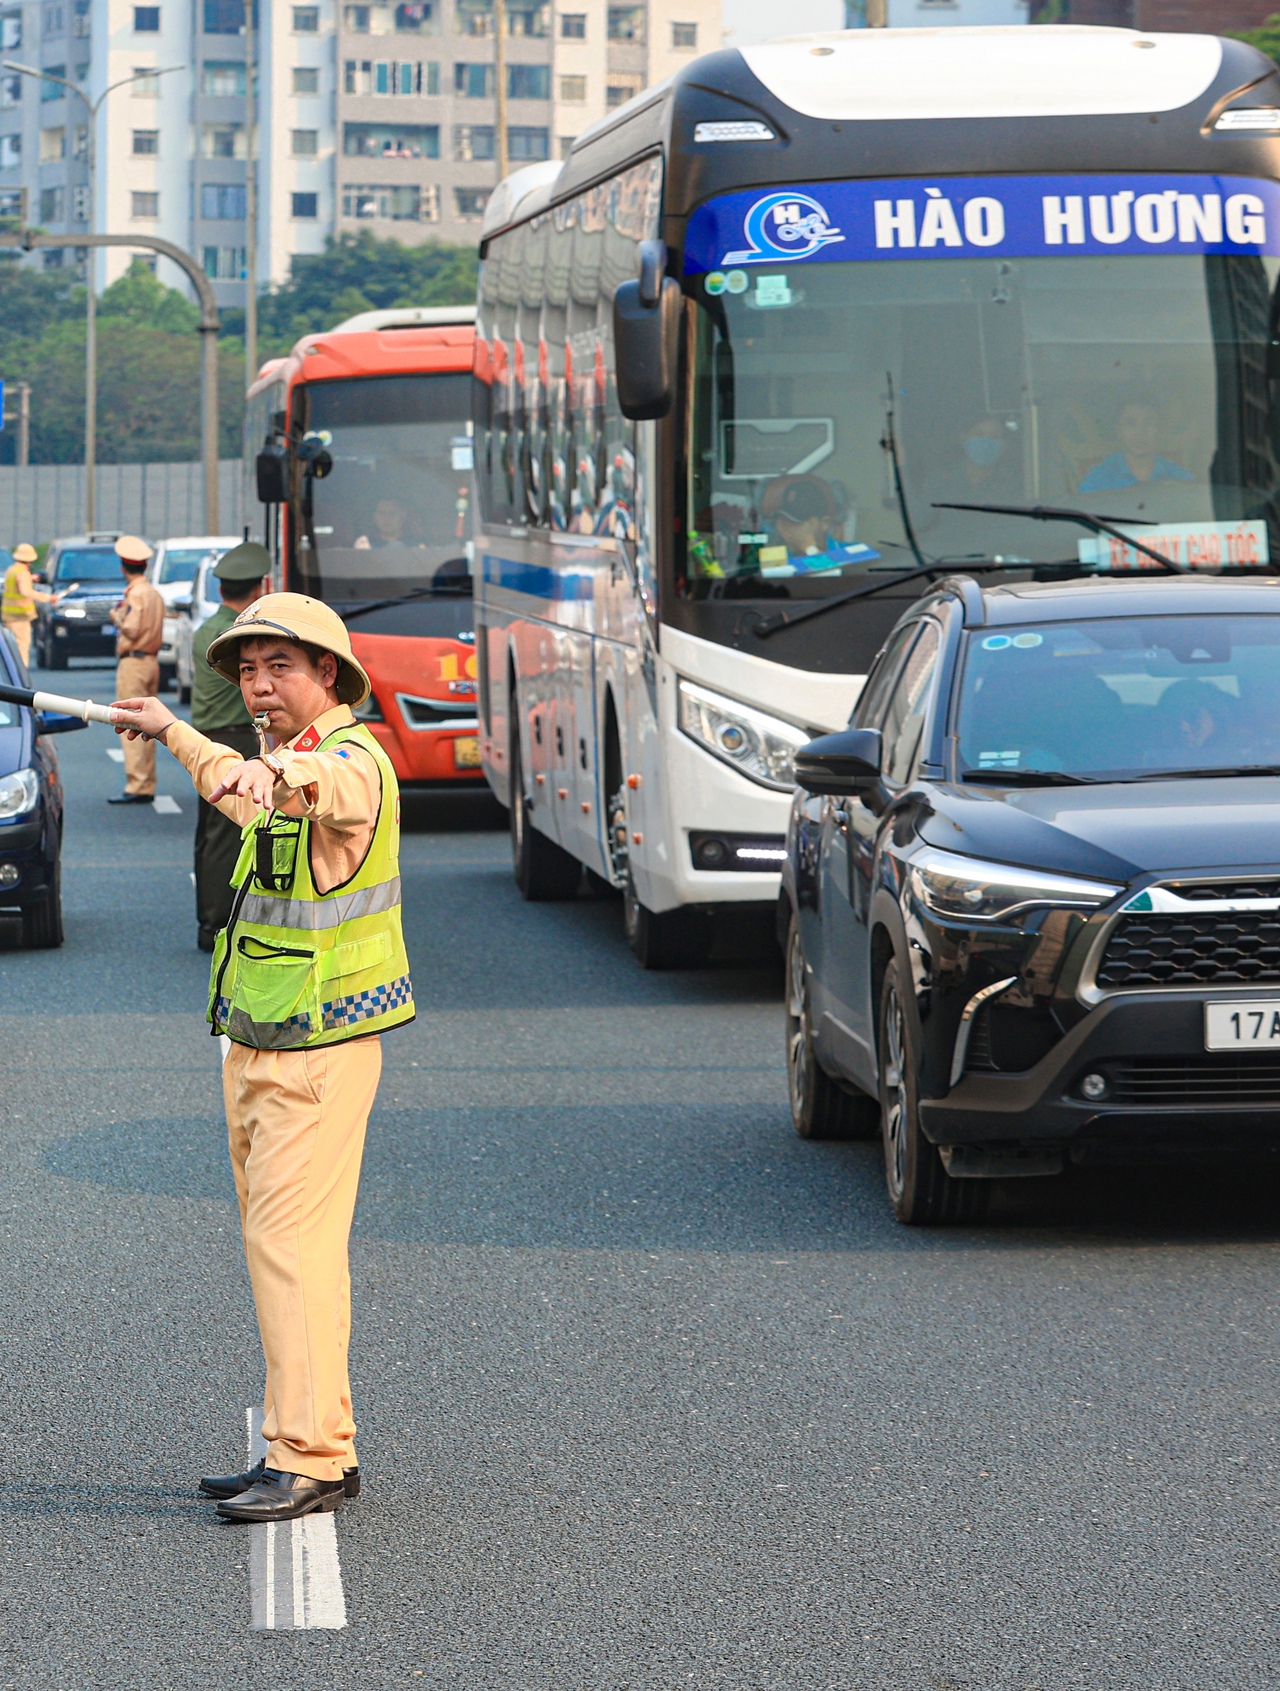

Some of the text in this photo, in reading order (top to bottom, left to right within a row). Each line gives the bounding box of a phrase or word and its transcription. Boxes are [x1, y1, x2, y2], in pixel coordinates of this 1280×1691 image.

[873, 187, 1266, 249] HÀO HƯƠNG
[1186, 533, 1221, 567] CAO
